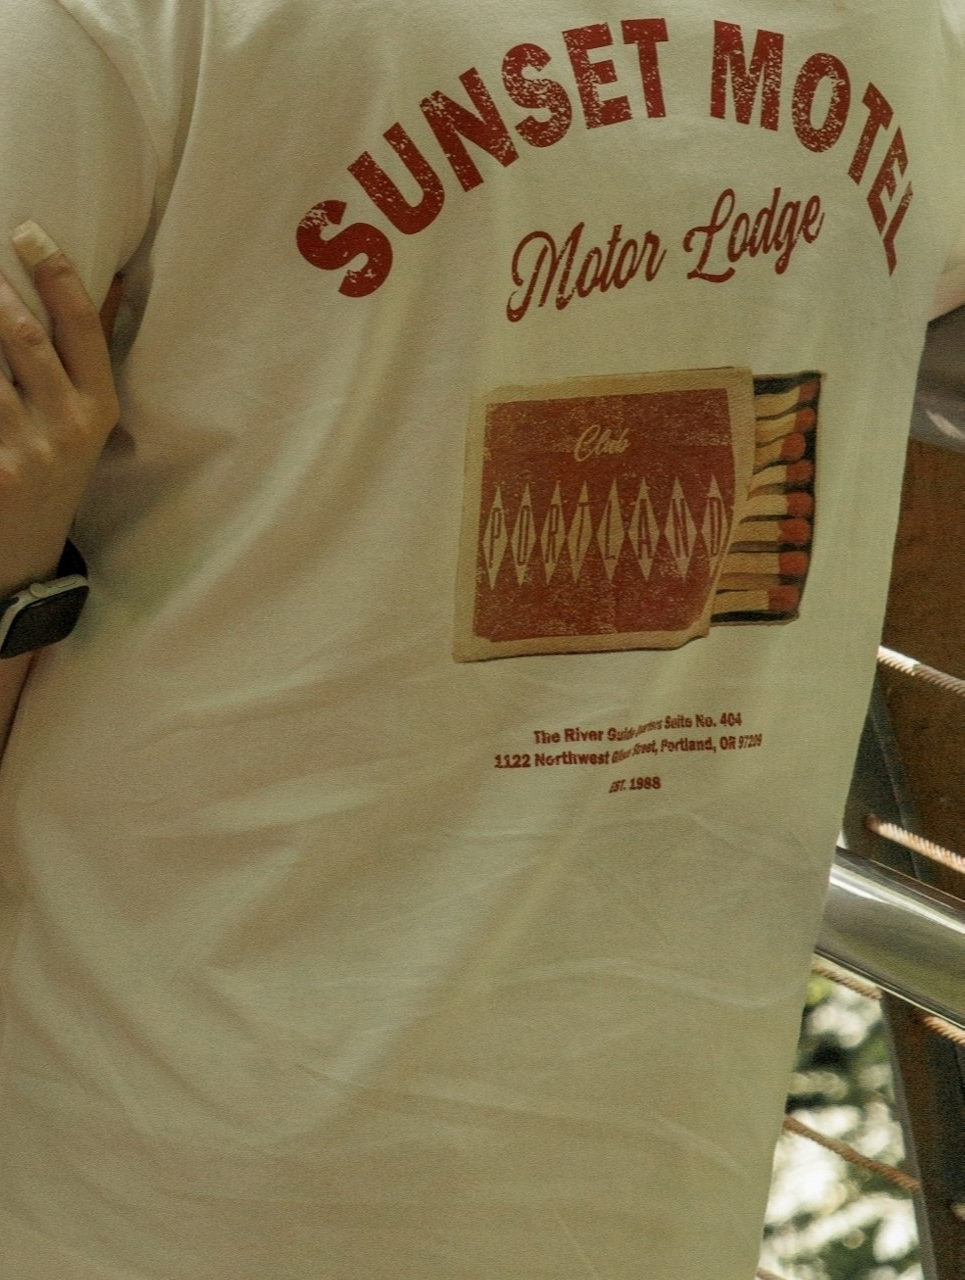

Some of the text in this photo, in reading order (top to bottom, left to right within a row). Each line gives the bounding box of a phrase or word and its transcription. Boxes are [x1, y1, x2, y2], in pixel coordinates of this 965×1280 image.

[296, 18, 914, 298] SUNSET MOTEL
[506, 187, 824, 322] Motor Lodge
[488, 496, 723, 569] PORTLAND
[494, 753, 531, 768] 1122
[534, 750, 610, 767] Northwest
[660, 736, 716, 754] Portland,
[720, 735, 736, 751] OR
[534, 729, 560, 744] The
[564, 726, 603, 742] River
[695, 713, 717, 728] No.
[720, 712, 742, 728] 404
[629, 776, 661, 791] 1988
